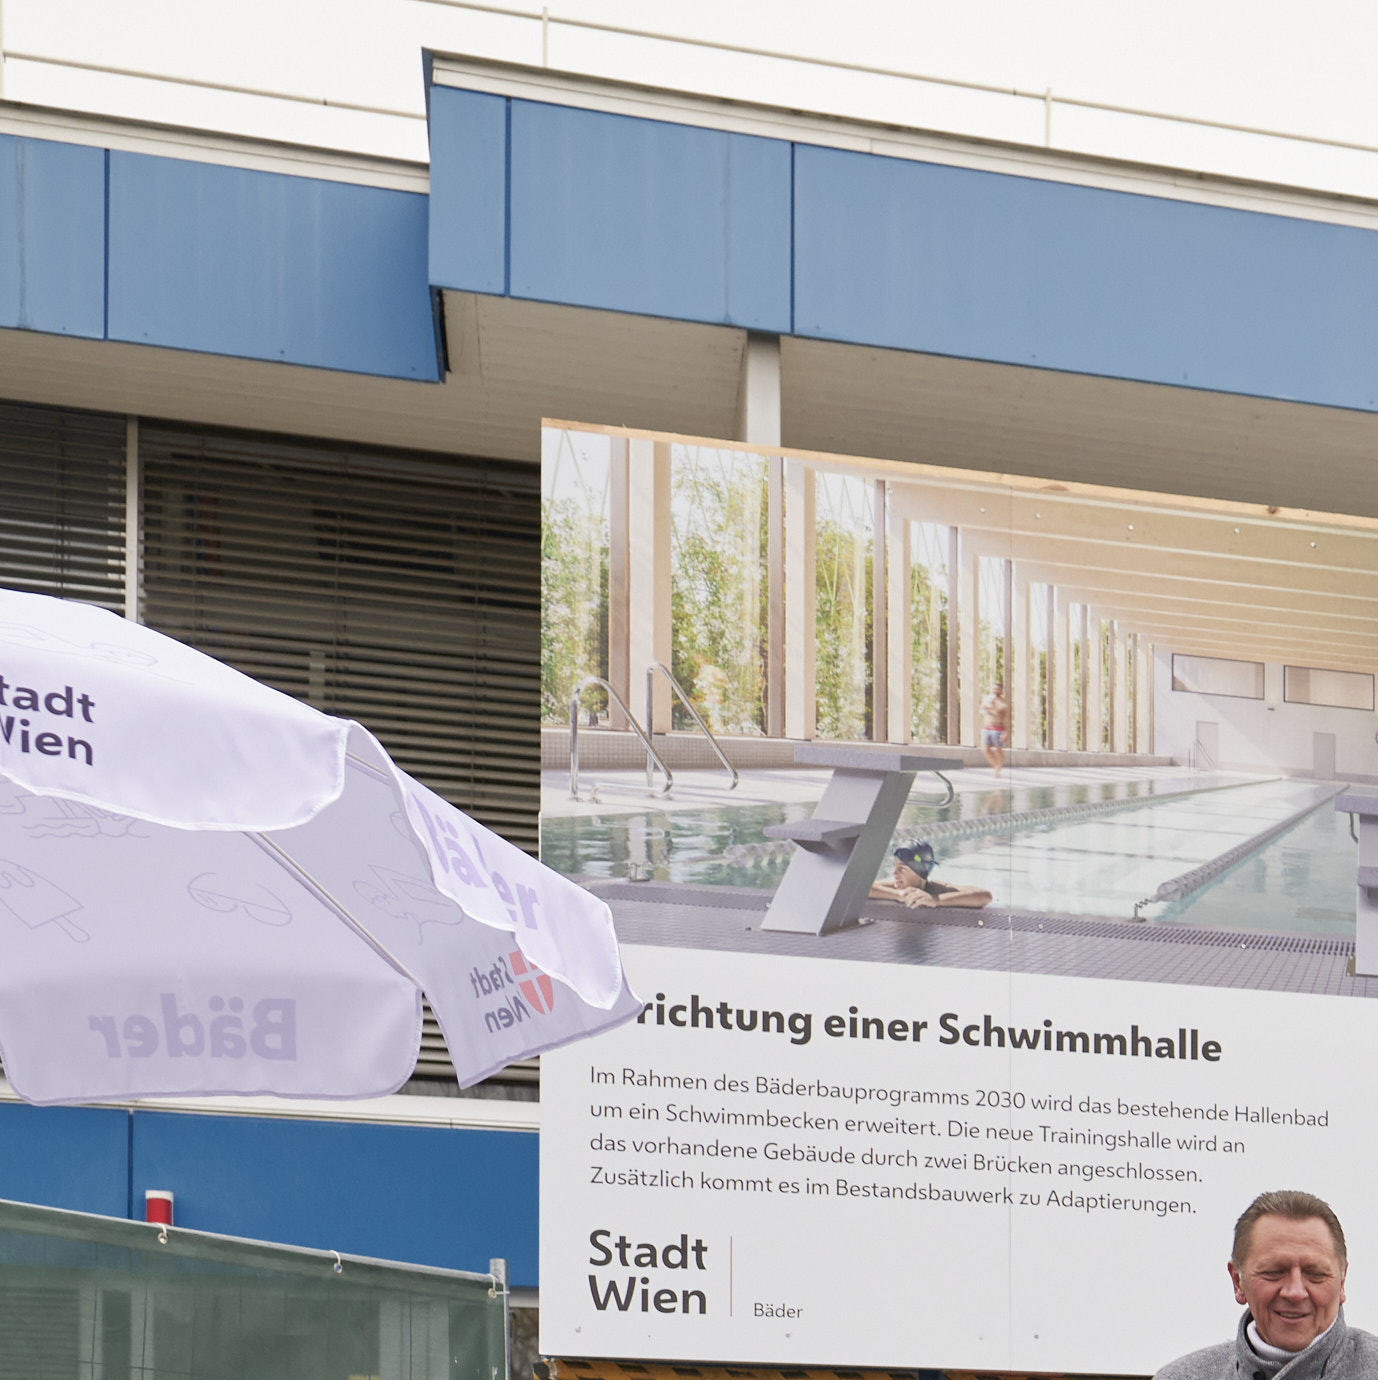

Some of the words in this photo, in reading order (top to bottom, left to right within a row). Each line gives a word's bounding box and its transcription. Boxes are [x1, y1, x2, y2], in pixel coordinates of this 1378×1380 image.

[0, 674, 96, 724] tadt
[637, 993, 812, 1045] richtung
[824, 1006, 928, 1042] einer
[939, 1011, 1222, 1062] Schwimmhalle
[592, 1066, 614, 1084] Im
[623, 1068, 707, 1090] Rahmen
[714, 1074, 749, 1092] des
[757, 1077, 969, 1106] Bäderbauprogramms
[976, 1090, 1025, 1109] 2030
[1031, 1095, 1072, 1111] wird
[1079, 1096, 1111, 1114] das
[1118, 1098, 1228, 1121] bestehende
[1235, 1106, 1328, 1126] Hallenbad
[591, 1105, 622, 1118] um
[629, 1103, 659, 1120] ein
[666, 1104, 838, 1130] Schwimmbecken
[845, 1118, 941, 1136] erweitert.
[949, 1120, 979, 1138] Die
[987, 1128, 1033, 1141] neue
[1039, 1126, 1171, 1151] Trainingshalle
[1177, 1135, 1216, 1151] wird
[1223, 1141, 1244, 1153] an
[591, 1133, 626, 1151] das
[633, 1137, 757, 1159] vorhandene
[764, 1143, 855, 1164] Gebäude
[862, 1148, 917, 1167] durch
[925, 1154, 966, 1169] zwei
[974, 1154, 1051, 1174] Brücken
[1058, 1162, 1202, 1182] angeschlossen.
[591, 1167, 693, 1188] Zusätzlich
[701, 1172, 772, 1192] kommt
[779, 1182, 799, 1193] es
[807, 1178, 829, 1195] im
[837, 1179, 1013, 1204] Bestandsbauwerk
[1020, 1194, 1040, 1205] zu
[1047, 1190, 1196, 1217] Adaptierungen.
[590, 1230, 708, 1270] Stadt
[588, 1275, 706, 1314] Wien
[754, 1303, 803, 1318] Bäder
